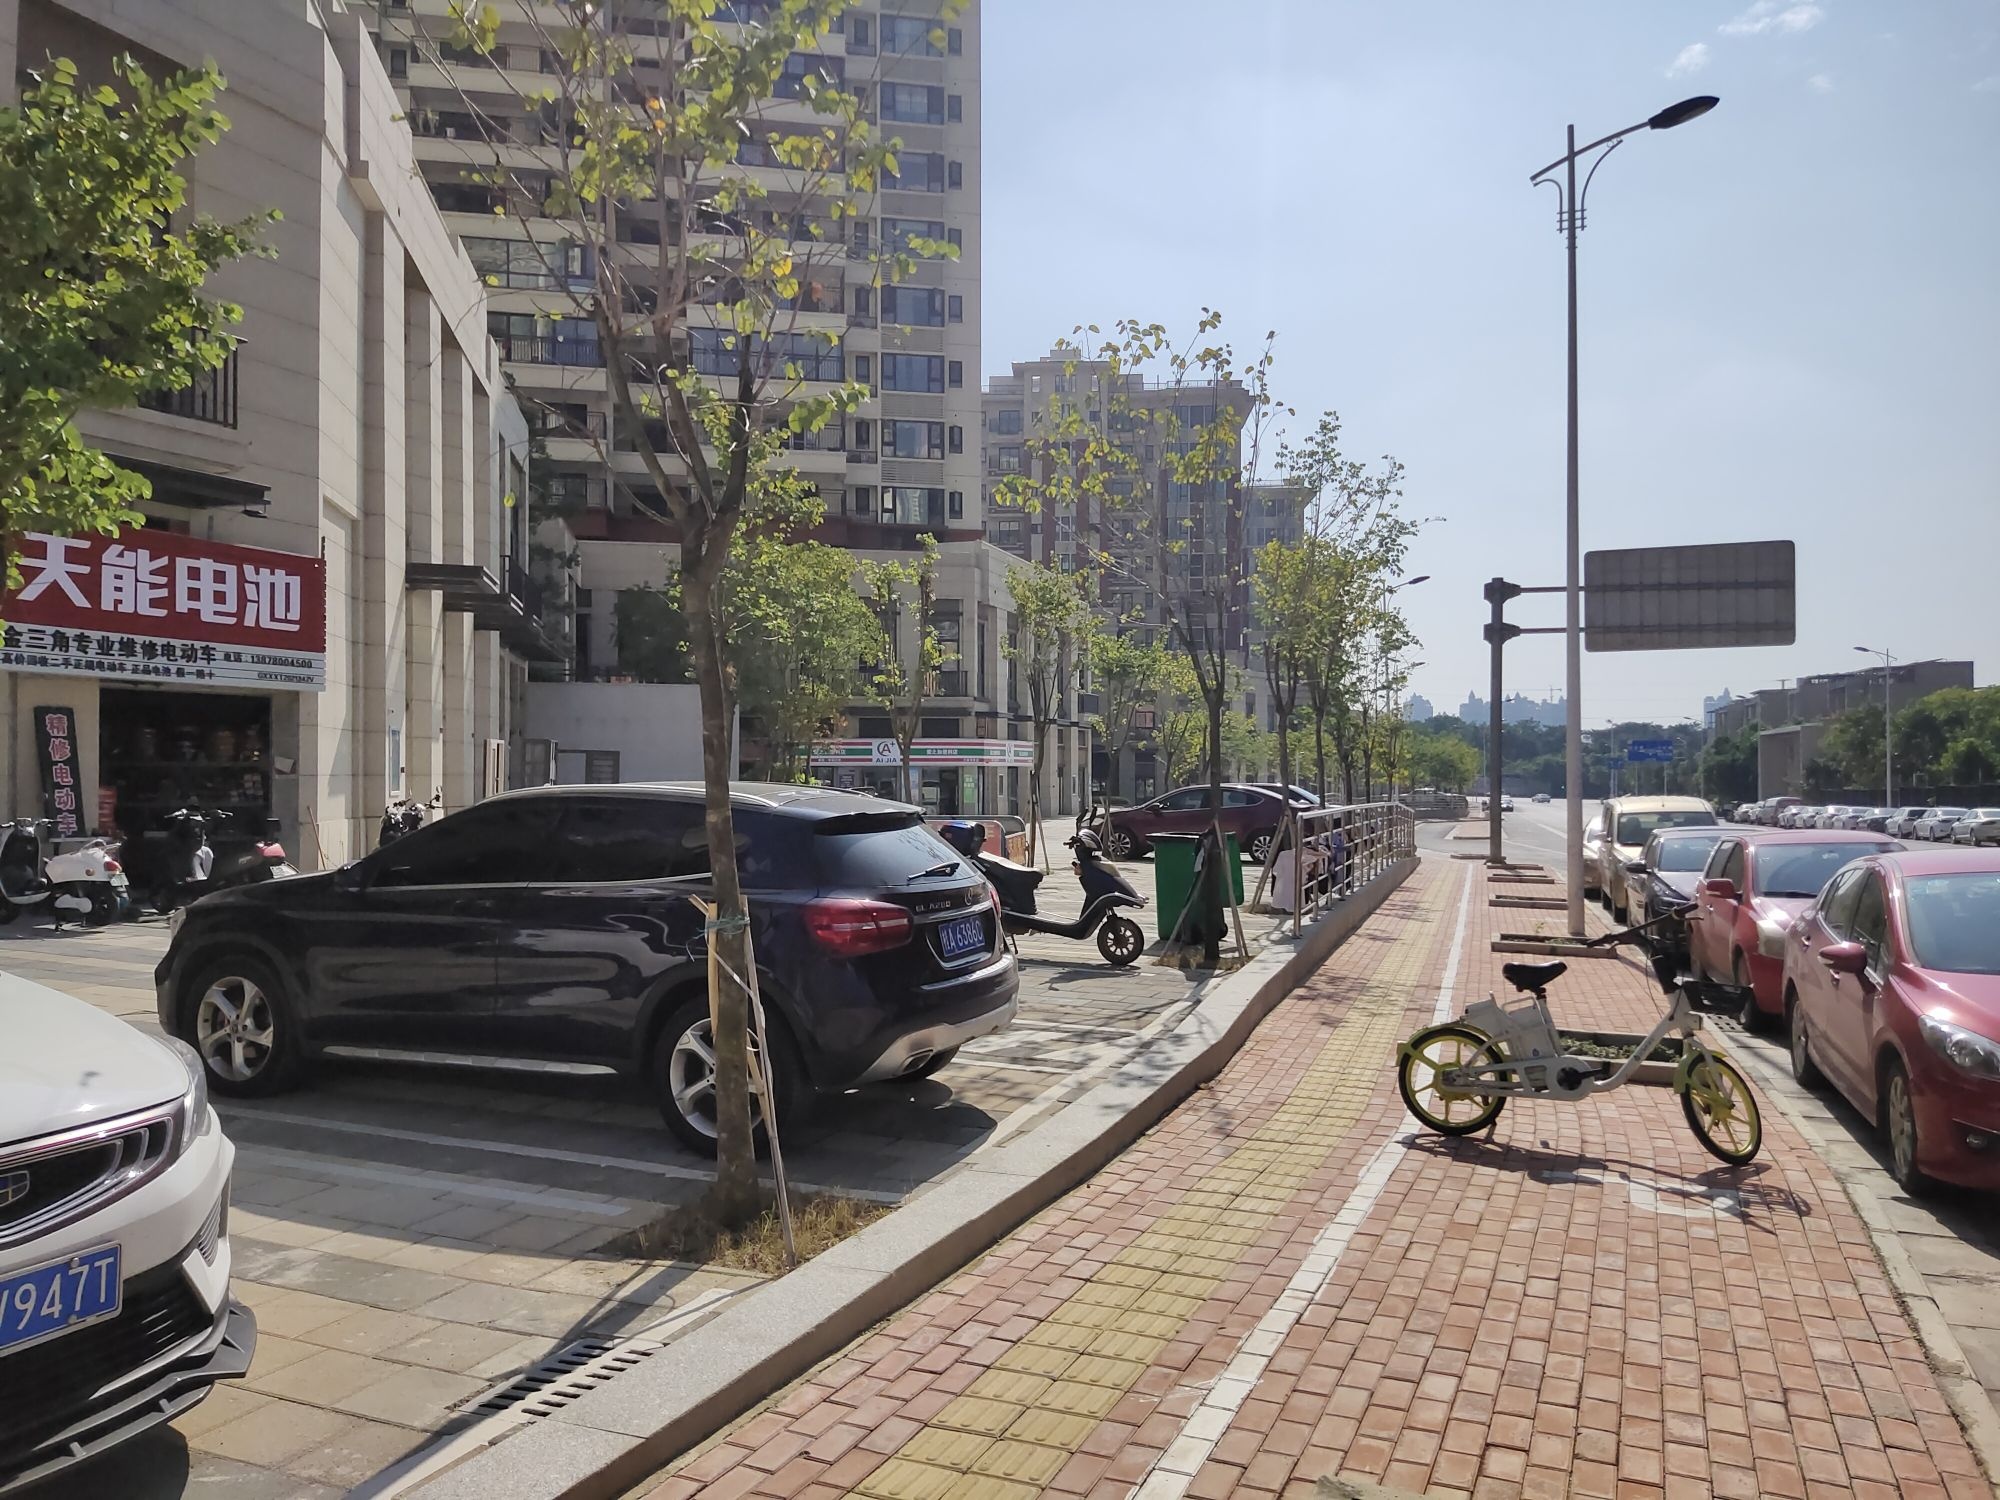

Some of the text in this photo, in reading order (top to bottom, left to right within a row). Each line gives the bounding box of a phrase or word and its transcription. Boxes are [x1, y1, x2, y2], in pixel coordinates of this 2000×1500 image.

[15, 530, 301, 633] 天能电池
[3, 625, 217, 665] 金三角专业维修电动车
[45, 713, 78, 836] 精修电动车
